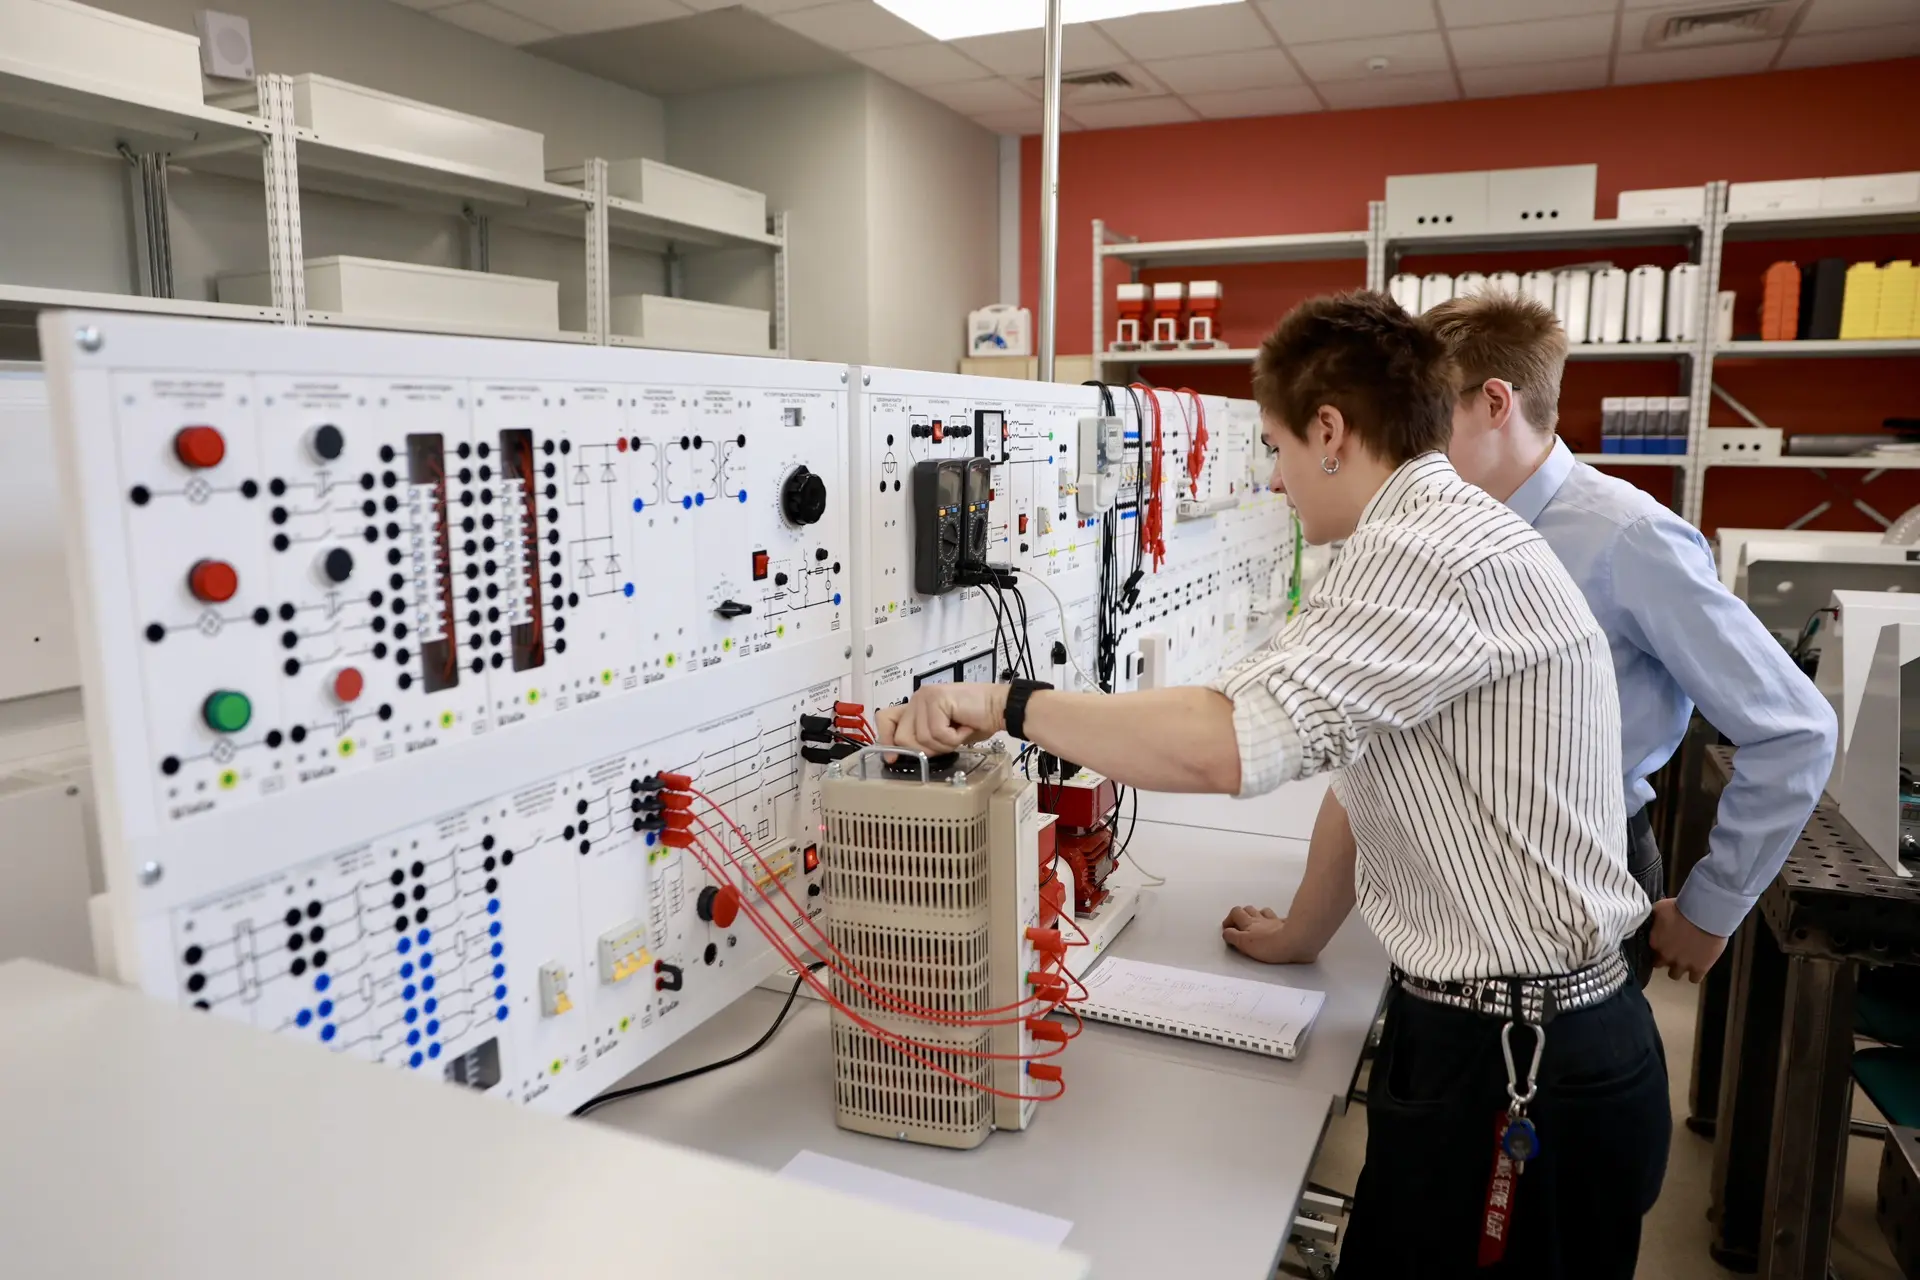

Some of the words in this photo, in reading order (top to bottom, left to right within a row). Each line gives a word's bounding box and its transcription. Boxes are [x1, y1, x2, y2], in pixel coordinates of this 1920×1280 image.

[1495, 1150, 1513, 1179] MOVE
[1490, 1179, 1510, 1210] BEFORE
[1486, 1210, 1505, 1241] FLIGHT
